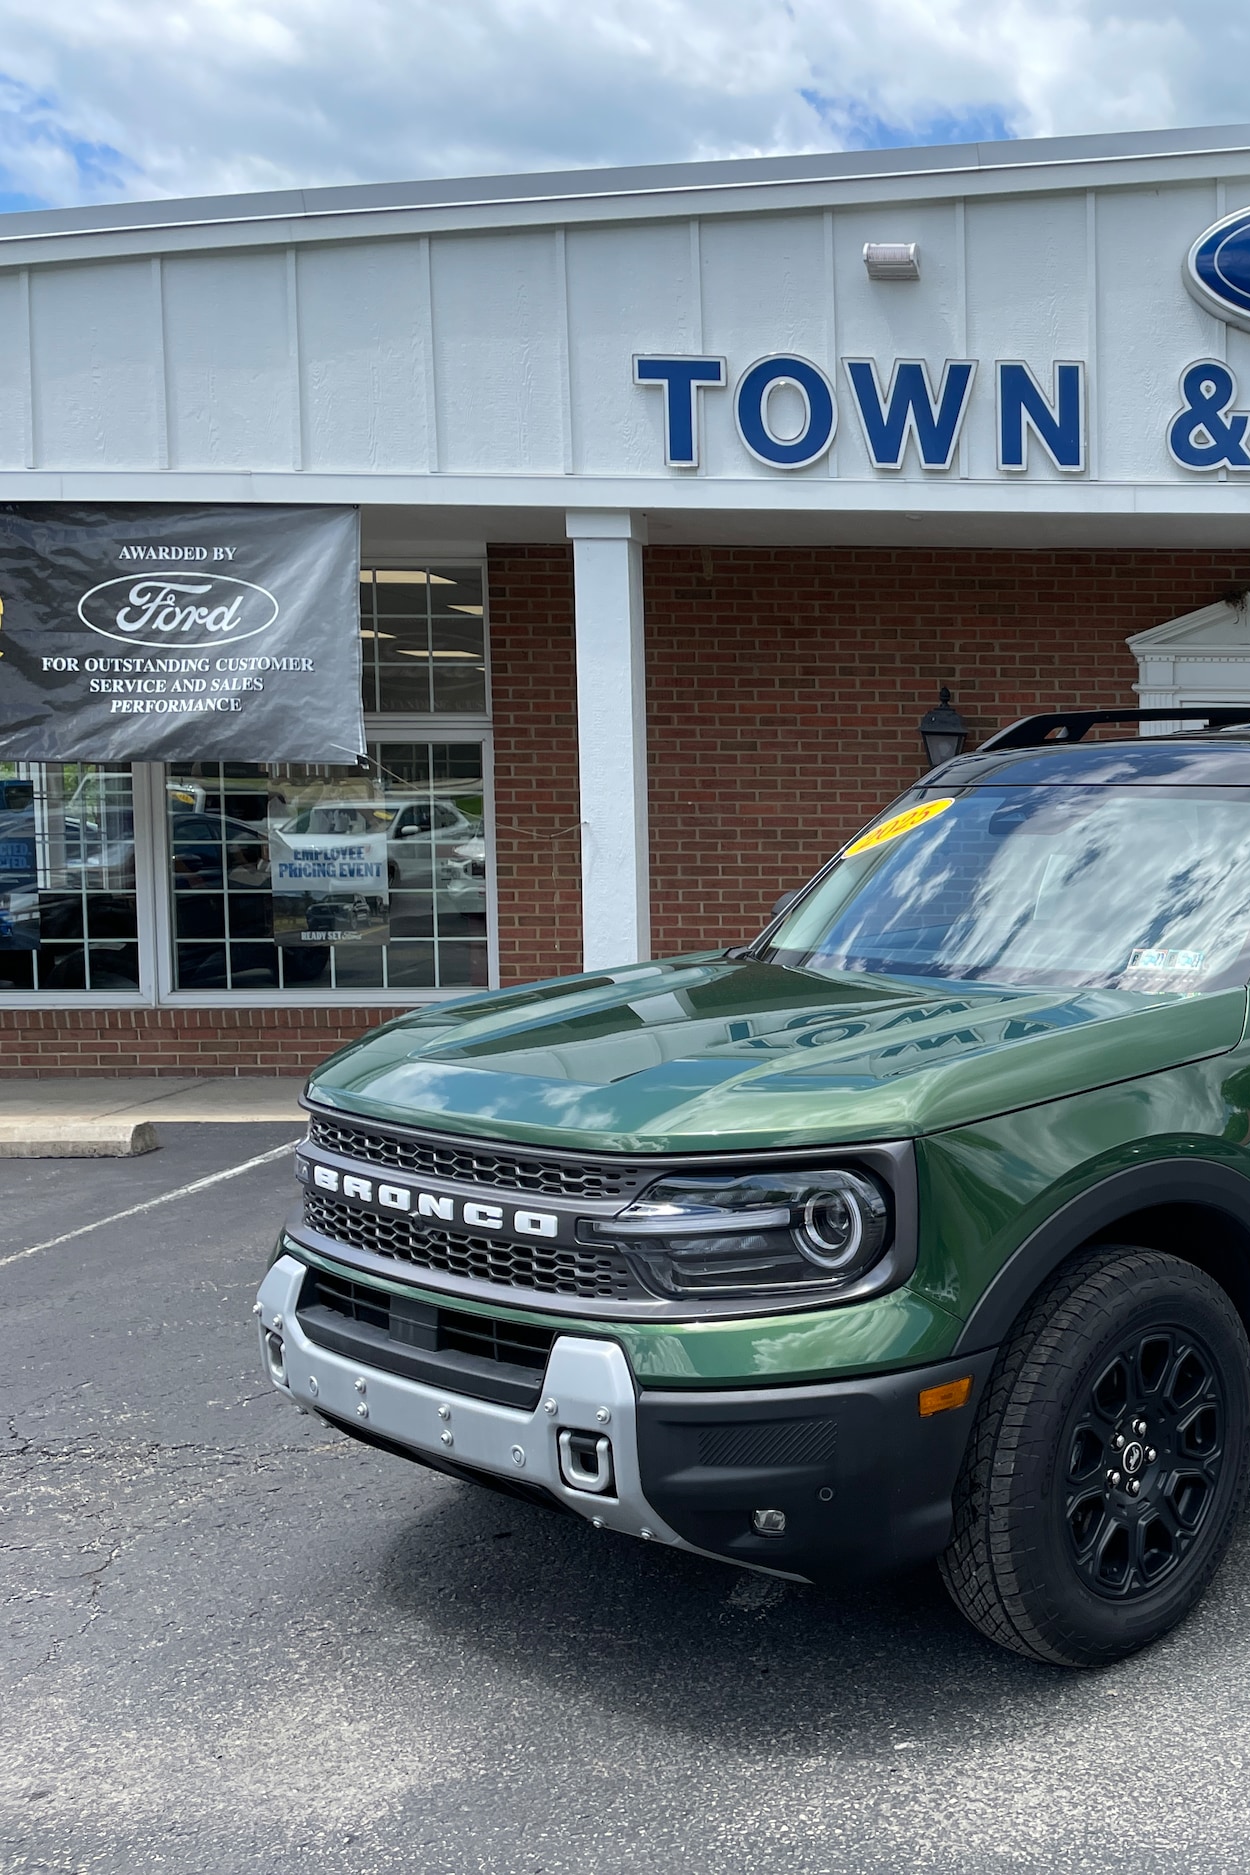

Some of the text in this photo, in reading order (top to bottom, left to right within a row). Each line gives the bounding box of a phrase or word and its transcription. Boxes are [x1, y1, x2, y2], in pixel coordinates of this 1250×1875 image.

[632, 352, 1085, 471] TOWN
[119, 545, 237, 561] AWARDED BY
[116, 581, 244, 632] Ford
[41, 656, 315, 673] FOR OUTSTANDING CUSTOMER
[89, 677, 265, 694] SERVICE AND SALES
[110, 697, 243, 714] PERFORMANCE
[856, 803, 937, 850] 2025
[292, 845, 366, 861] EMPLOYEE
[278, 862, 382, 878] PRICING EVENT
[301, 931, 326, 941] READY
[326, 931, 342, 941] SET
[313, 1164, 559, 1238] BRONCO
